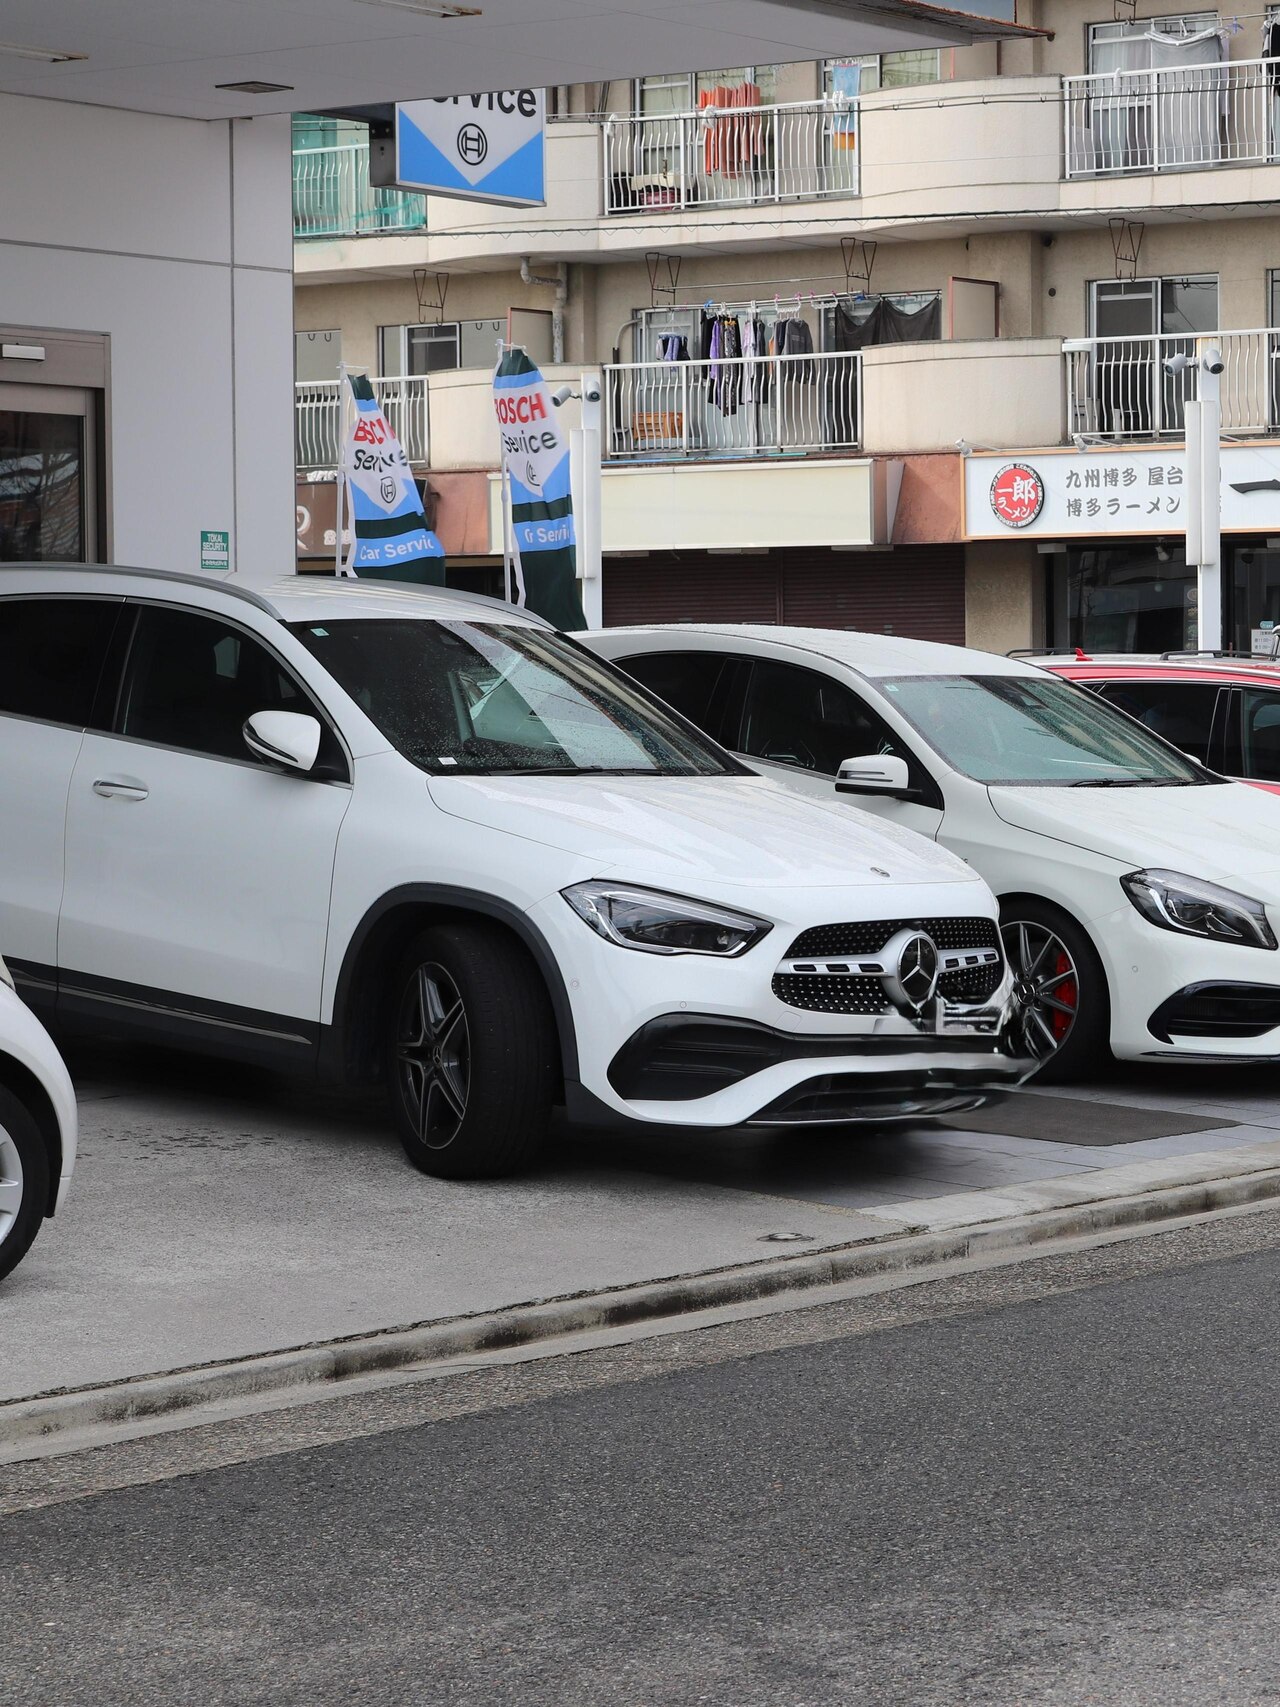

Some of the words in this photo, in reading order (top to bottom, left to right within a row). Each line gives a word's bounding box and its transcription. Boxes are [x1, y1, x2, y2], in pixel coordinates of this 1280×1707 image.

[1065, 467, 1138, 489] 九州博多
[996, 476, 1036, 506] 一郎
[997, 496, 1031, 519] ラーメン
[202, 542, 228, 551] SECURITY
[207, 533, 223, 543] TOKAI
[360, 546, 380, 561] Car
[384, 535, 435, 558] Servic
